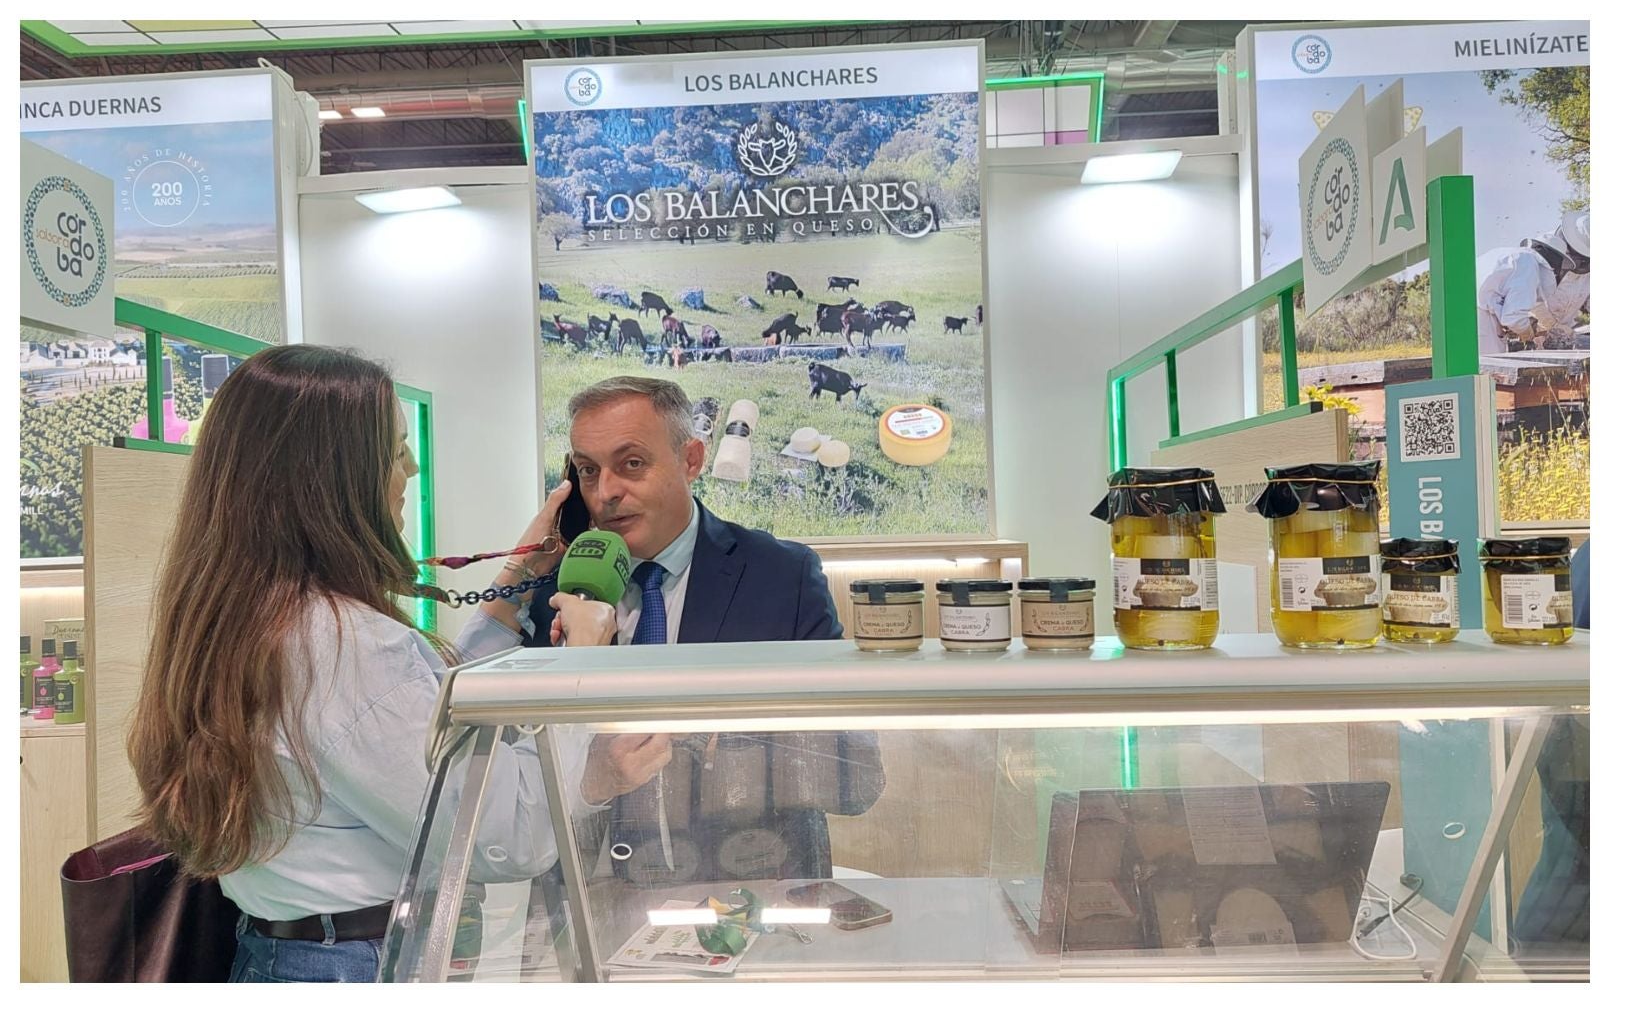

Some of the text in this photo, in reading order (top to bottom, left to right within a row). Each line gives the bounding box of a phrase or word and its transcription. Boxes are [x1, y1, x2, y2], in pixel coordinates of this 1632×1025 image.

[1453, 32, 1589, 58] MIELINÍZATE
[684, 66, 878, 93] LOS BALANCHARES
[20, 97, 162, 119] INCA DUERNAS
[151, 181, 183, 197] 200
[587, 180, 935, 239] LOS BALANCHARES
[588, 217, 874, 242] SELECCIÓN EN QUESO
[1418, 476, 1443, 516] LOS
